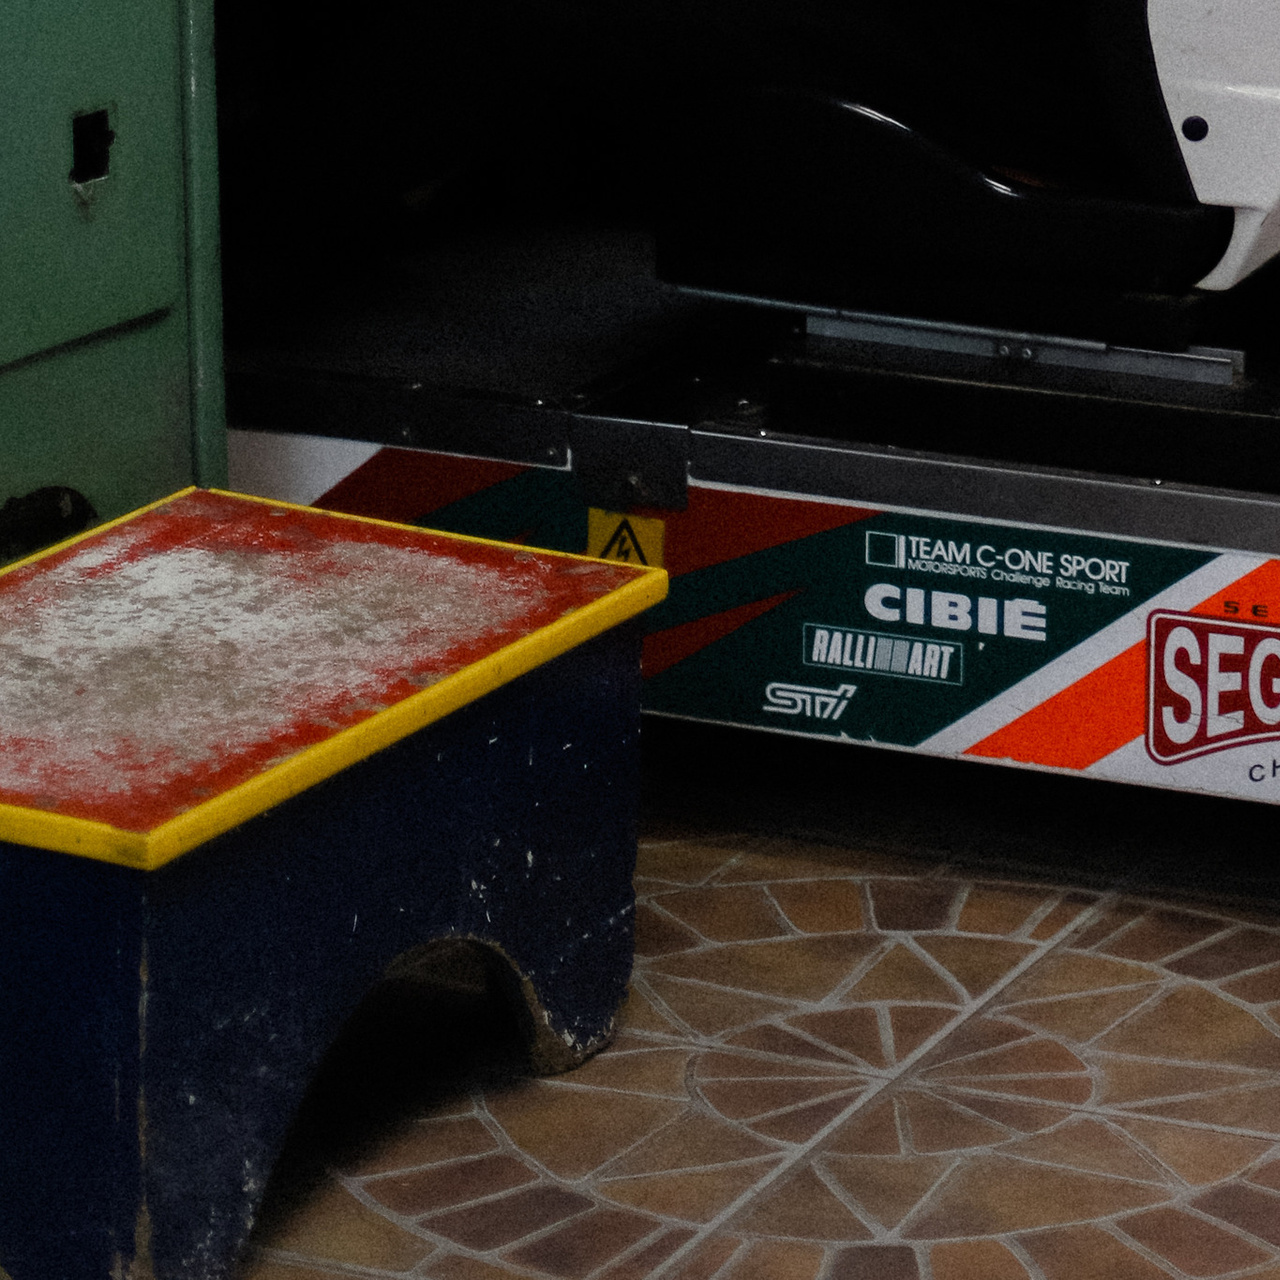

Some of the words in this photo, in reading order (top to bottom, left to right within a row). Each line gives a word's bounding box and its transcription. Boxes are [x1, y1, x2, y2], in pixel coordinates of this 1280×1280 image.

[907, 558, 987, 579] MOTORSPORTS
[991, 569, 1050, 588] Challenge
[1056, 577, 1095, 595] Racing
[1098, 581, 1130, 597] Team
[908, 535, 970, 565] TEAM
[976, 544, 1054, 574] C-ONE
[1060, 553, 1130, 583] SPORT
